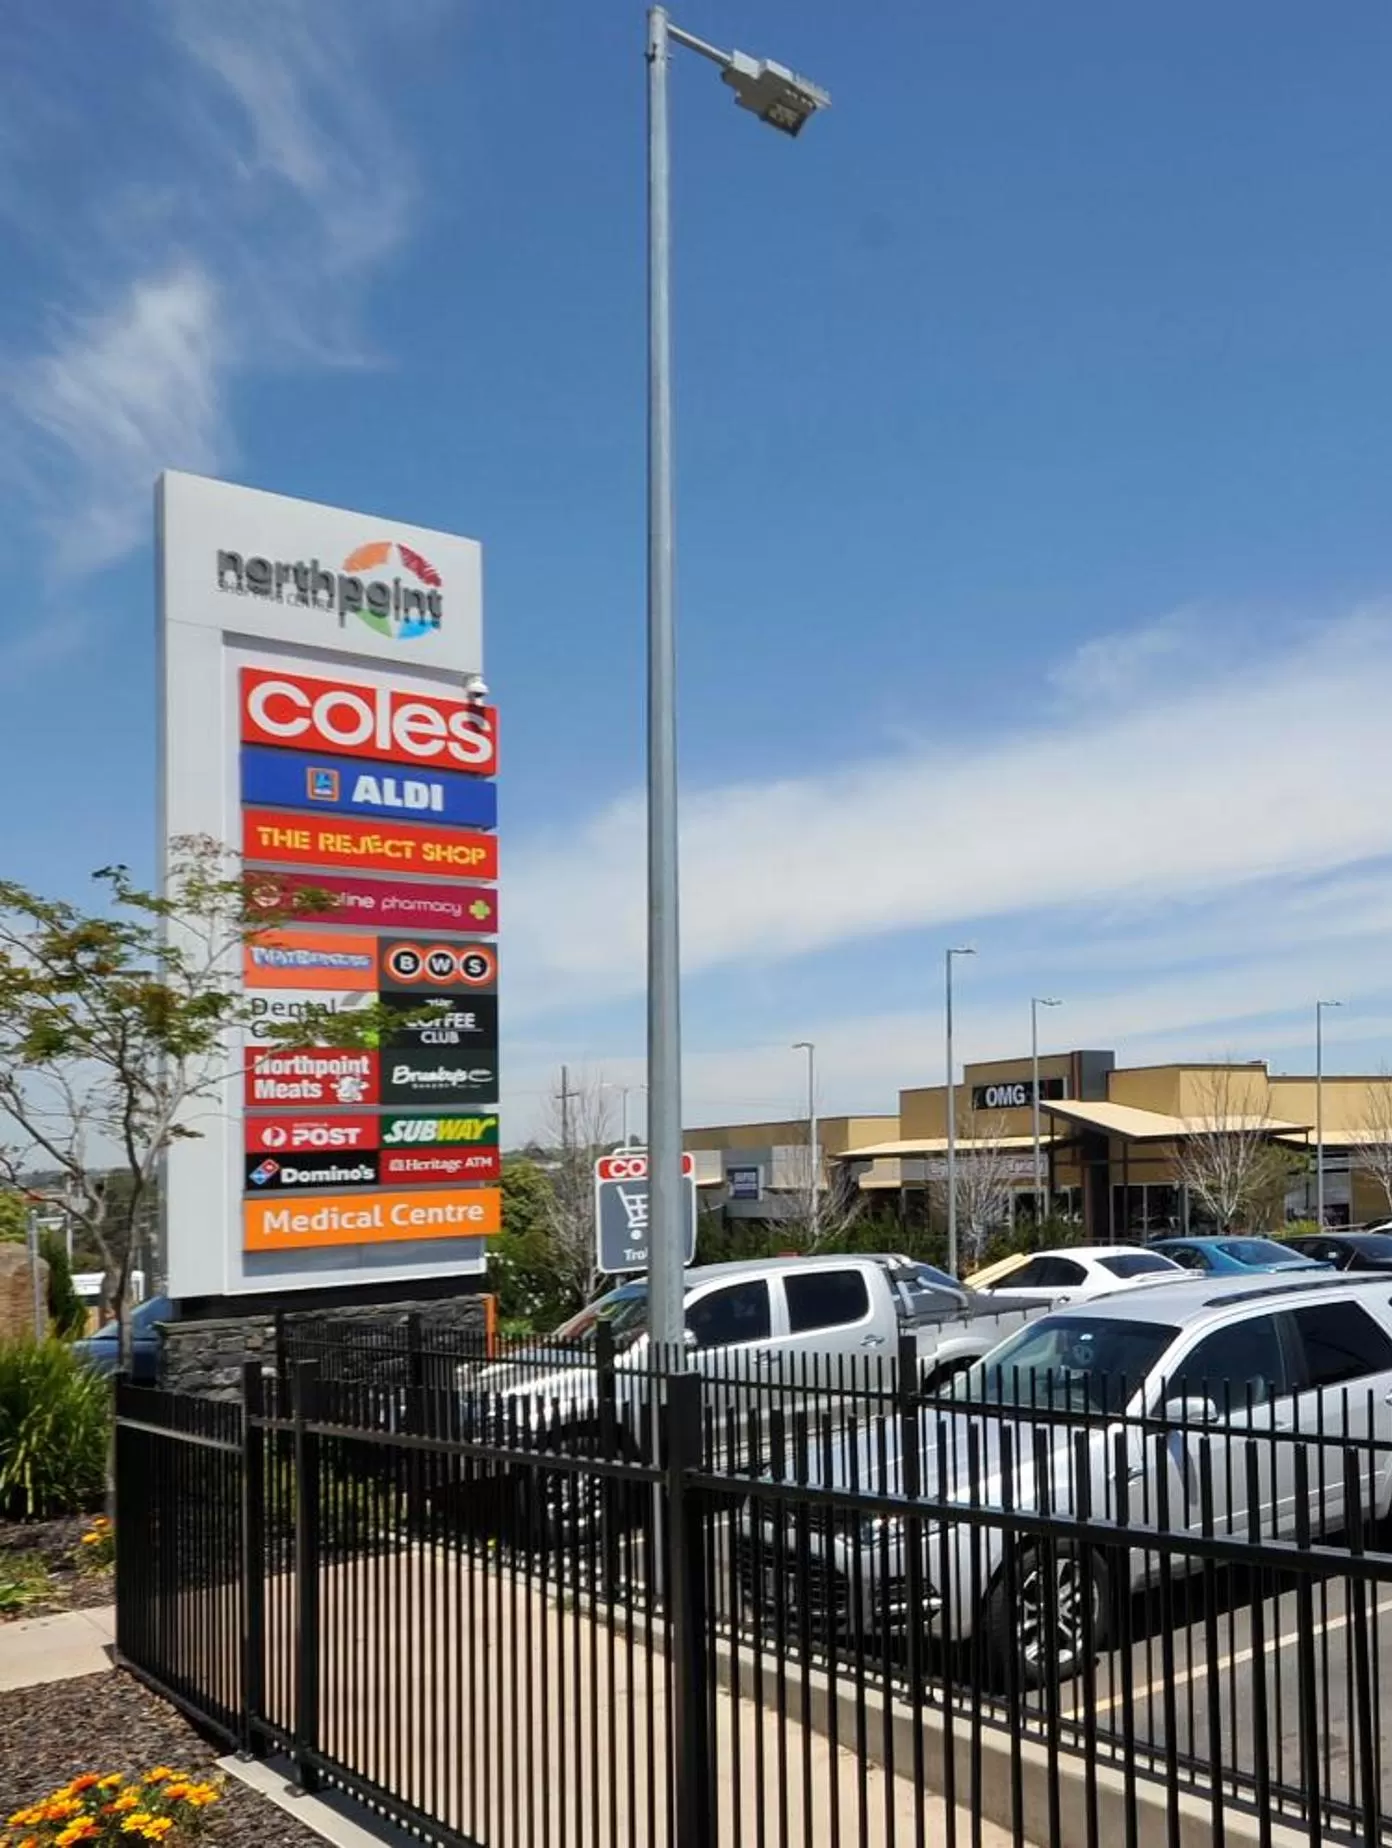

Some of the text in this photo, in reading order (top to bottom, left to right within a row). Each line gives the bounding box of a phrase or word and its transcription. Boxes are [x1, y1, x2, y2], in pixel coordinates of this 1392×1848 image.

[216, 549, 444, 630] northpoint
[247, 680, 494, 764] coles
[352, 775, 444, 812] ALDI
[257, 826, 487, 866] THE REJECT SHOP
[381, 893, 463, 918] pharmacy
[420, 1030, 460, 1044] CLUB
[254, 1055, 370, 1079] Northpoint
[254, 1079, 323, 1099] Meats
[985, 1084, 1026, 1107] OMG
[292, 1127, 363, 1146] POST
[383, 1117, 497, 1143] SUBWAY
[281, 1164, 376, 1184] Domino's
[406, 1156, 493, 1173] Heritage ATM
[263, 1203, 485, 1234] Medical Centre
